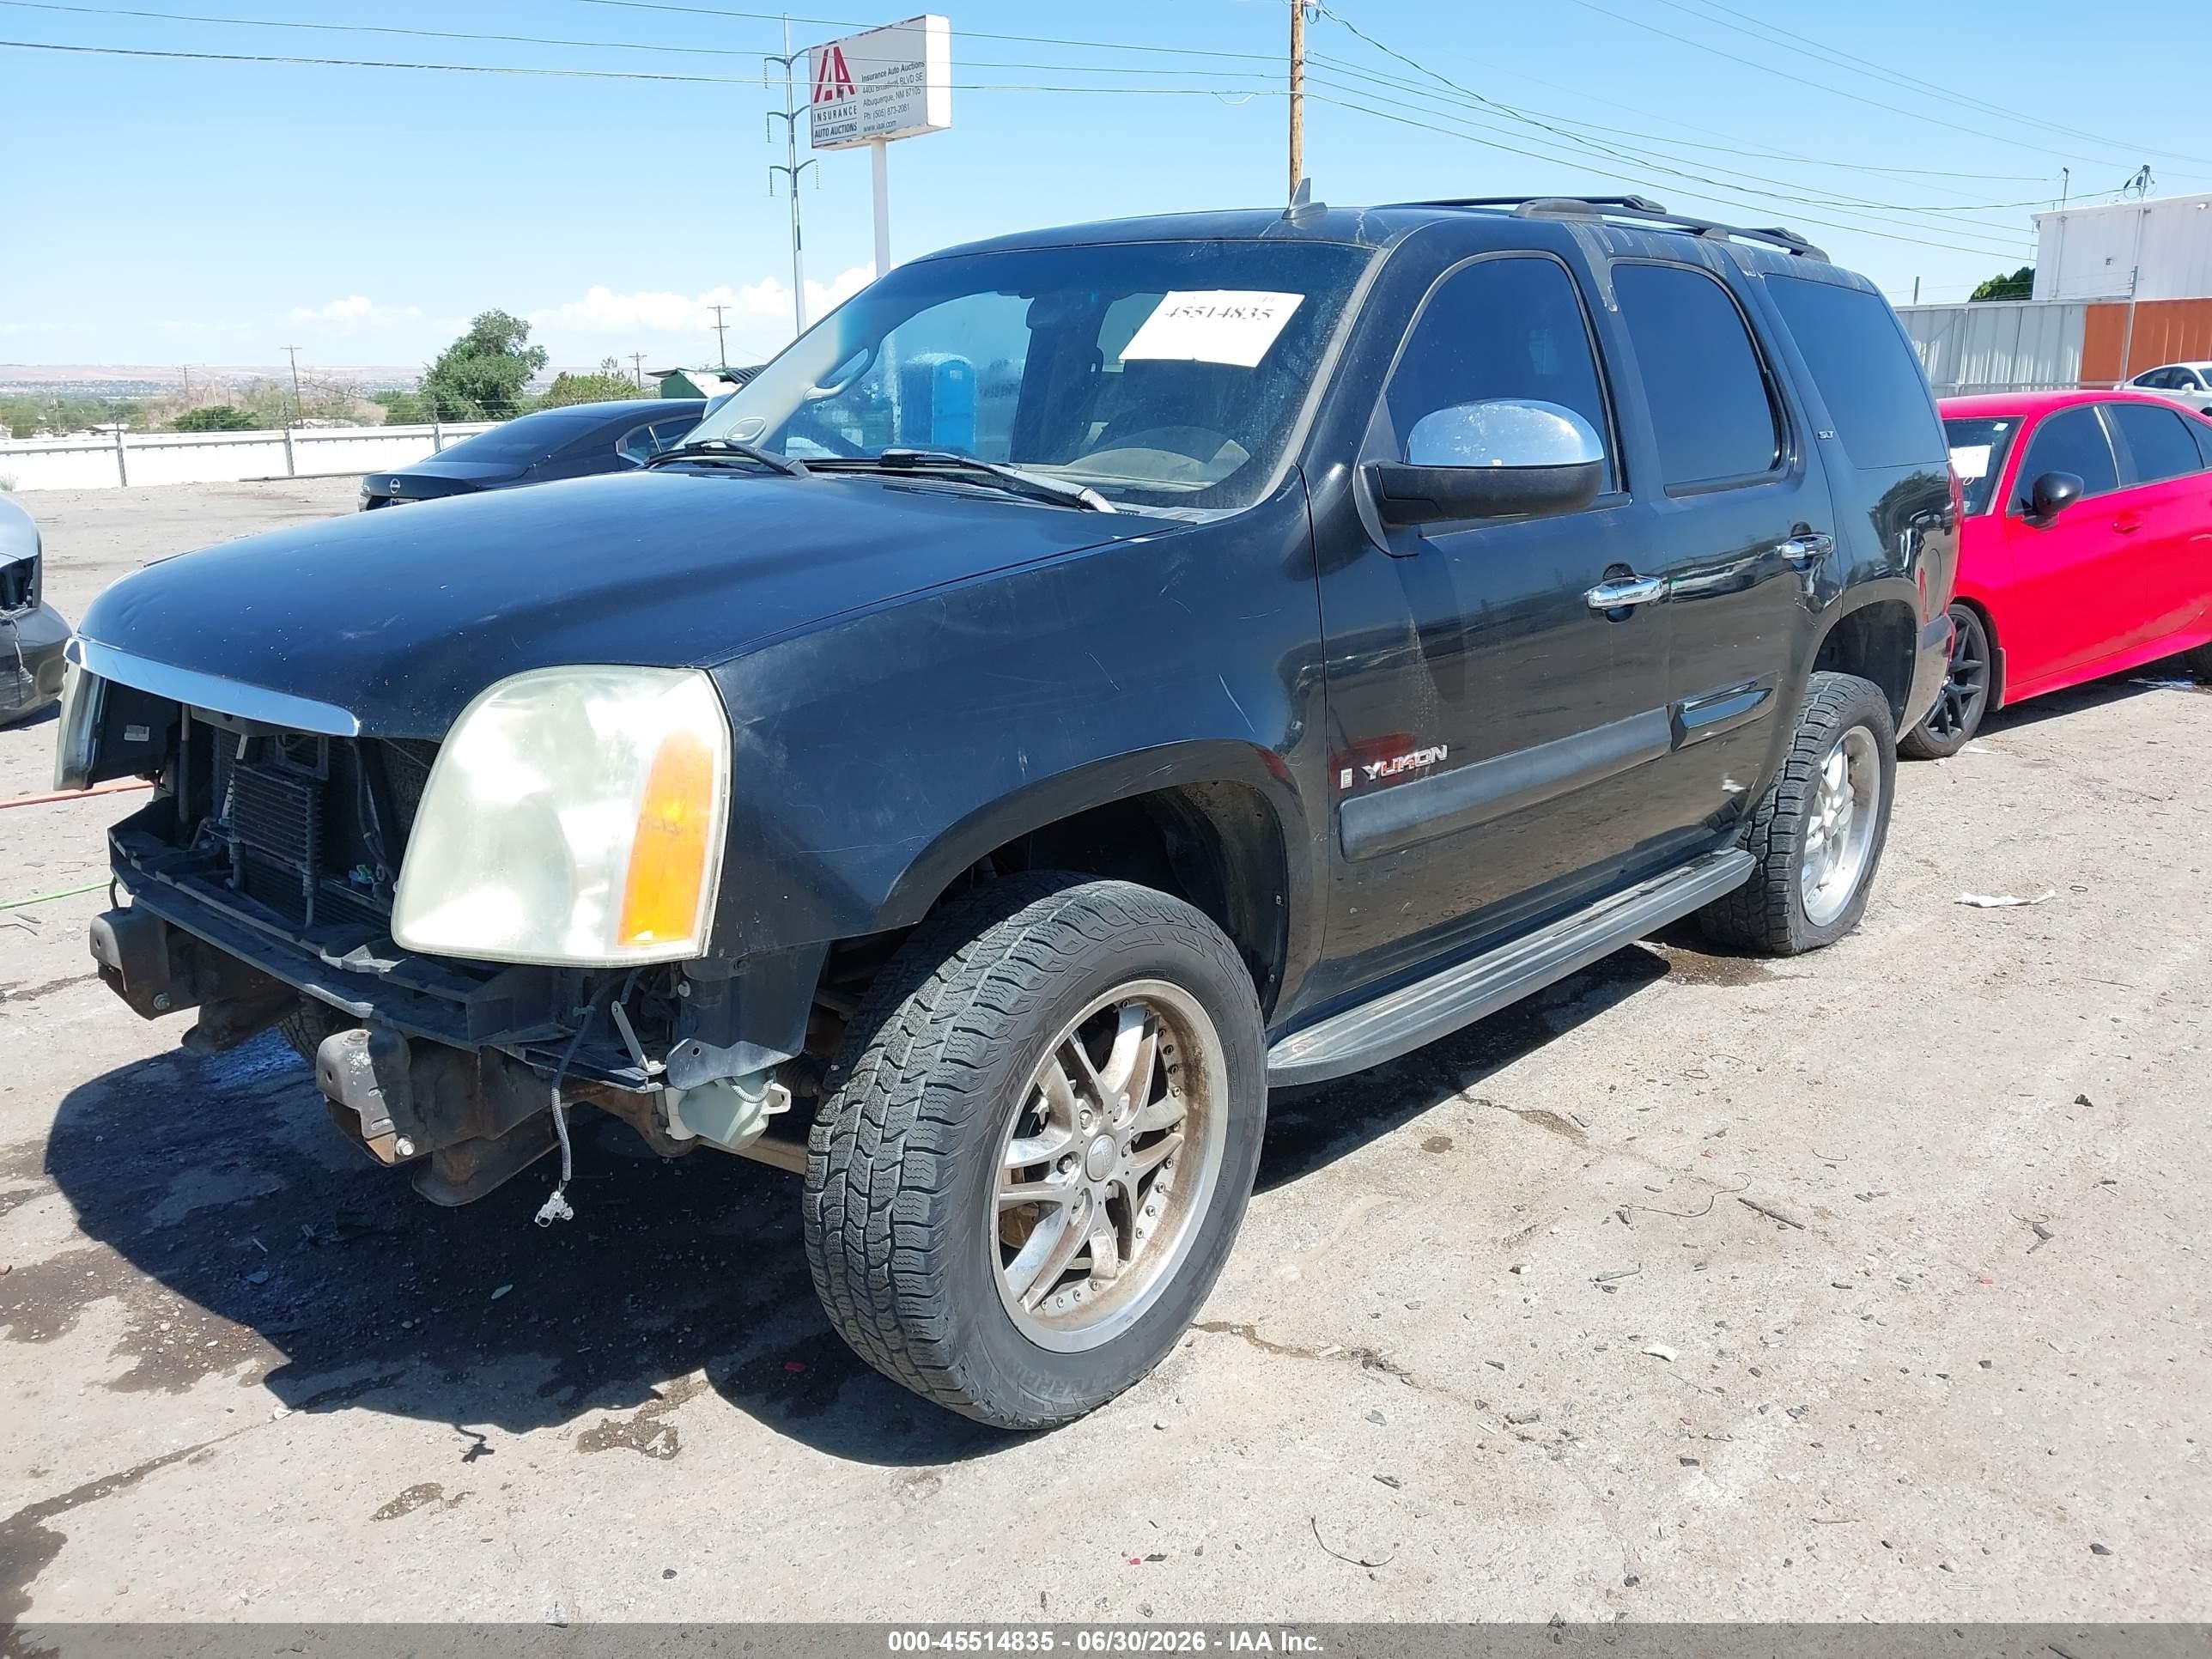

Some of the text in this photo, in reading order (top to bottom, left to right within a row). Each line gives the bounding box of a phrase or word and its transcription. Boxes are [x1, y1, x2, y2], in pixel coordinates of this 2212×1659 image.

[861, 60, 926, 83] Insurance Auto Auctions
[899, 74, 915, 85] BLVD
[915, 71, 923, 82] SE
[896, 89, 905, 100] NM
[813, 105, 857, 123] INSURANCE
[814, 121, 858, 139] AUTO AUCTIONS
[1165, 305, 1275, 321] 45514835
[1818, 430, 1835, 440] SLT
[1361, 744, 1449, 781] YUKON
